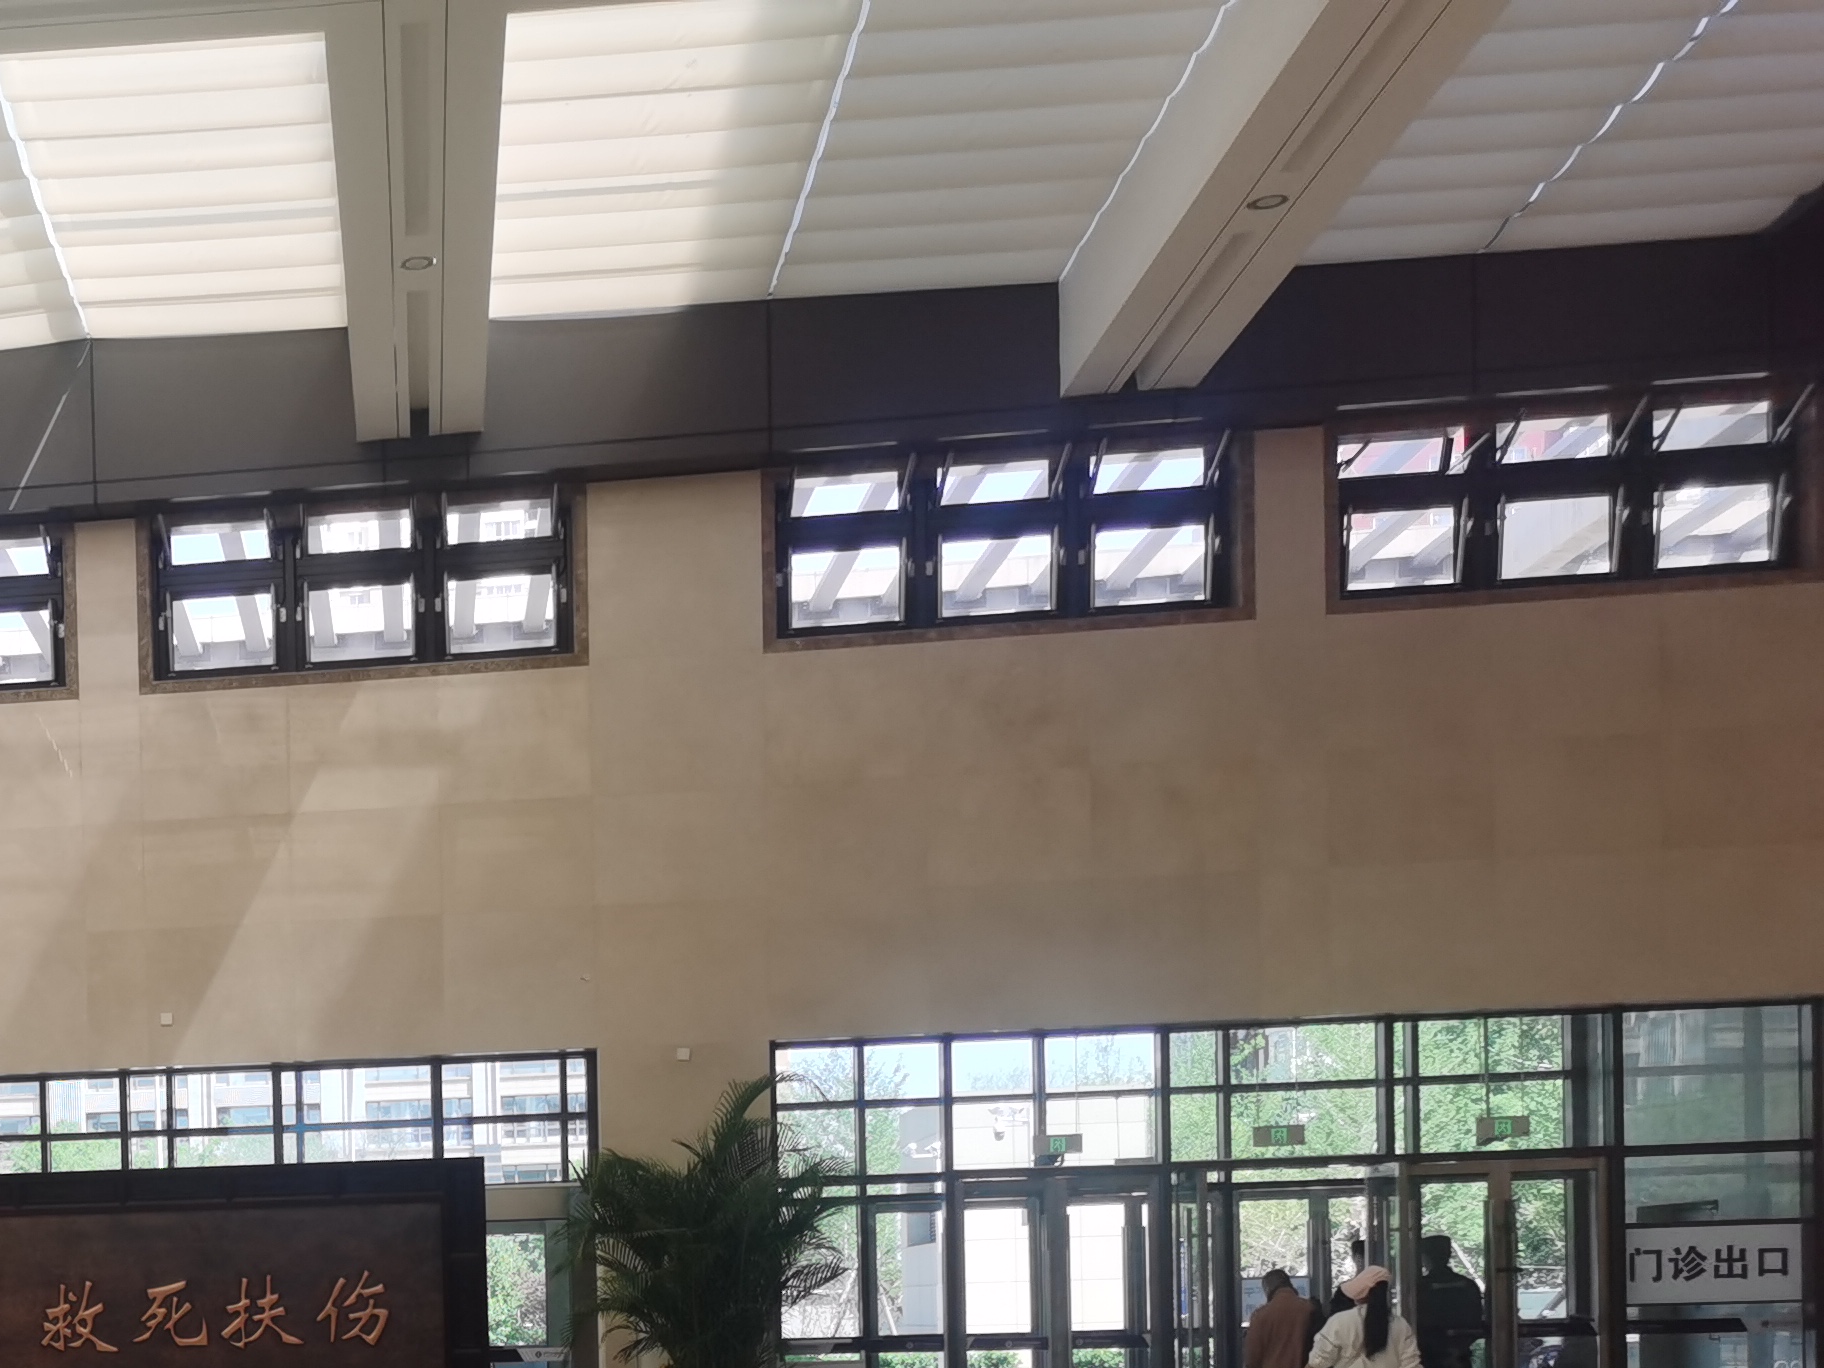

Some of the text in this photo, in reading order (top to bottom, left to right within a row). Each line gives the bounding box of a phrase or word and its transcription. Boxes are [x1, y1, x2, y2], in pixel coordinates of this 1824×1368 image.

[1629, 1245, 1788, 1283] 门诊出口
[40, 1270, 389, 1352] 救死扶伤
